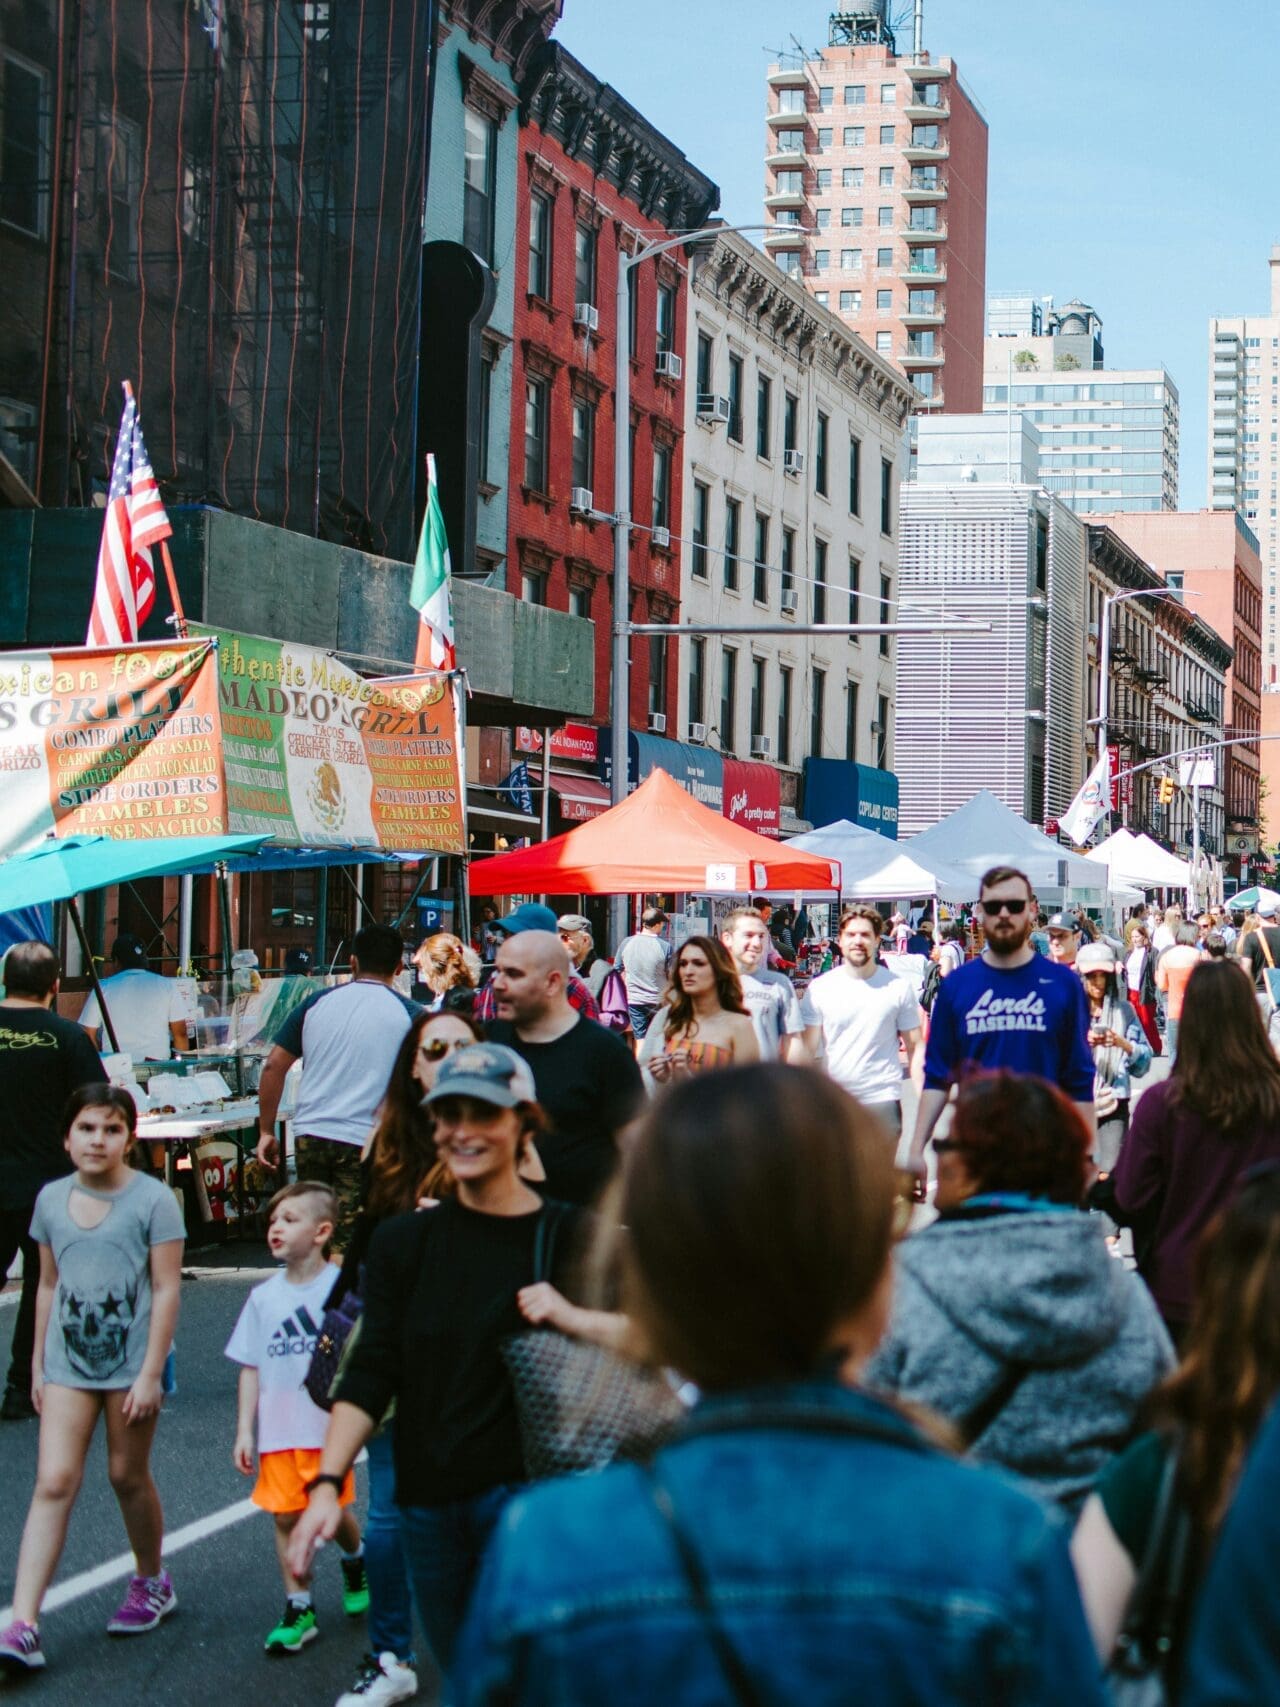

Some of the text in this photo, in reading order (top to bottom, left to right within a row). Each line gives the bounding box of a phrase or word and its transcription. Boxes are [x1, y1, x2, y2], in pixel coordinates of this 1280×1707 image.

[219, 639, 304, 688] thentic
[29, 684, 195, 728] GRILL
[218, 679, 440, 736] MADEO'S GRILL
[52, 713, 214, 750] COMBO PLATTERS
[312, 724, 345, 738] TACOS
[168, 738, 212, 756] ASADA
[394, 739, 452, 757] PLATTERS
[580, 740, 594, 752] FOOD
[56, 767, 111, 788] CHIPOTLE
[154, 758, 182, 778] TACO
[182, 756, 217, 774] SALAD
[422, 757, 451, 770] ASADA
[58, 785, 116, 809] SIDE
[120, 776, 220, 801] ORDERS
[401, 788, 456, 804] ORDERS
[73, 796, 210, 825] TAMELES
[378, 805, 451, 820] TAMELES
[748, 806, 763, 822] pretty
[763, 807, 777, 819] color
[858, 800, 898, 823] COPYLAND CENTER
[139, 816, 224, 840] NACHOS
[417, 821, 460, 836] NACHOS
[426, 910, 437, 927] P
[965, 988, 1047, 1020] Lords
[966, 1014, 1047, 1035] BASEBALL
[266, 1337, 316, 1358] adida
